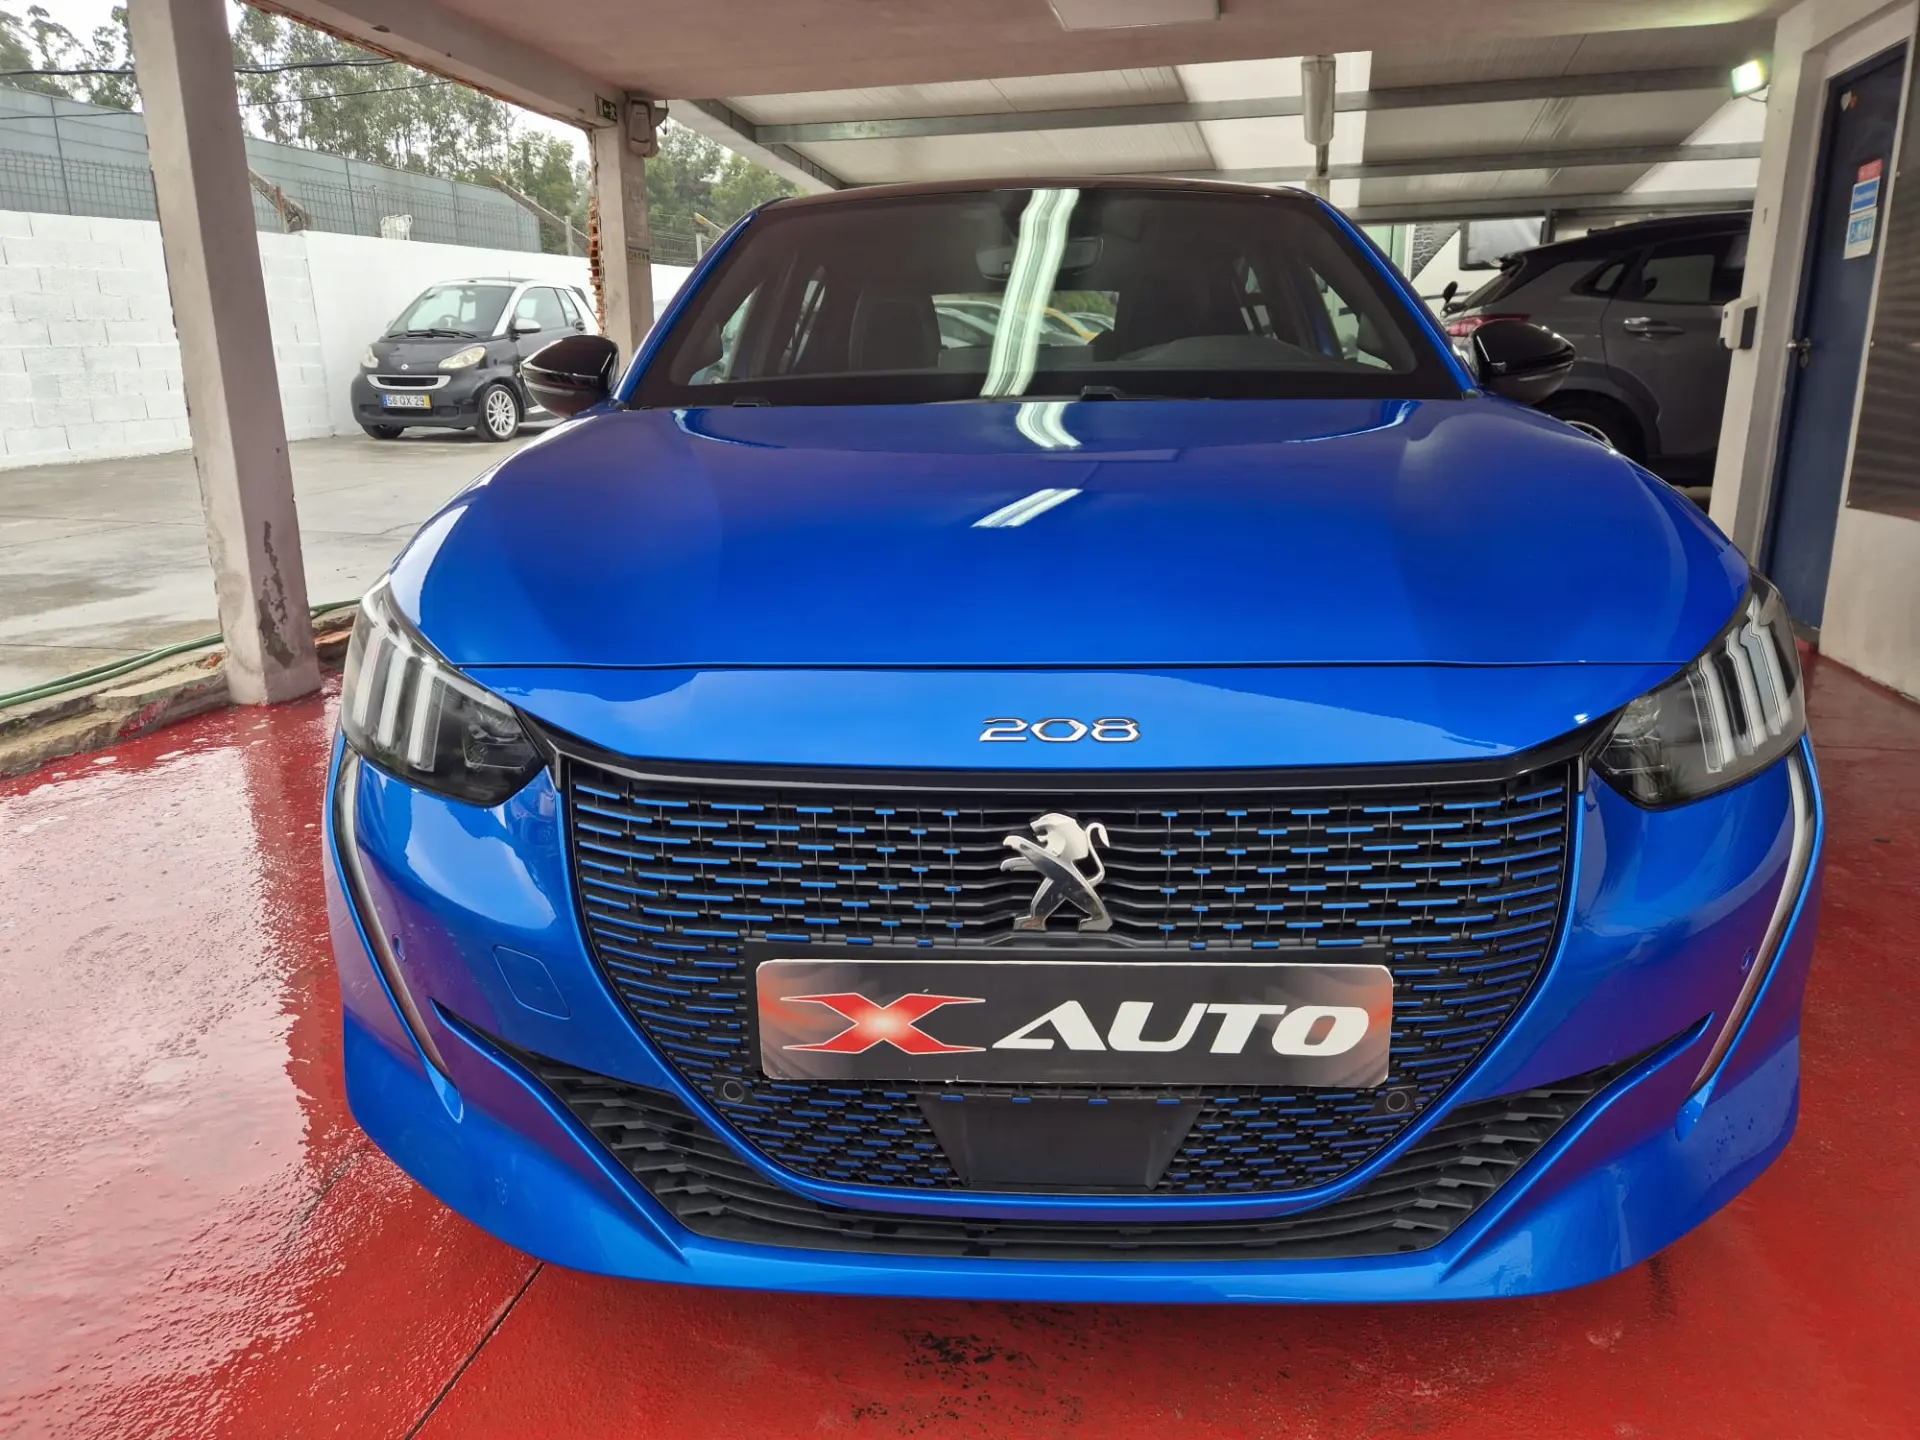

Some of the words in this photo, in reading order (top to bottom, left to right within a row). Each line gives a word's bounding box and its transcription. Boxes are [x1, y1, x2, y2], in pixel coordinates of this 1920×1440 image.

[979, 717, 1141, 743] 208
[779, 992, 987, 1055] X
[991, 1000, 1370, 1057] AUTO
